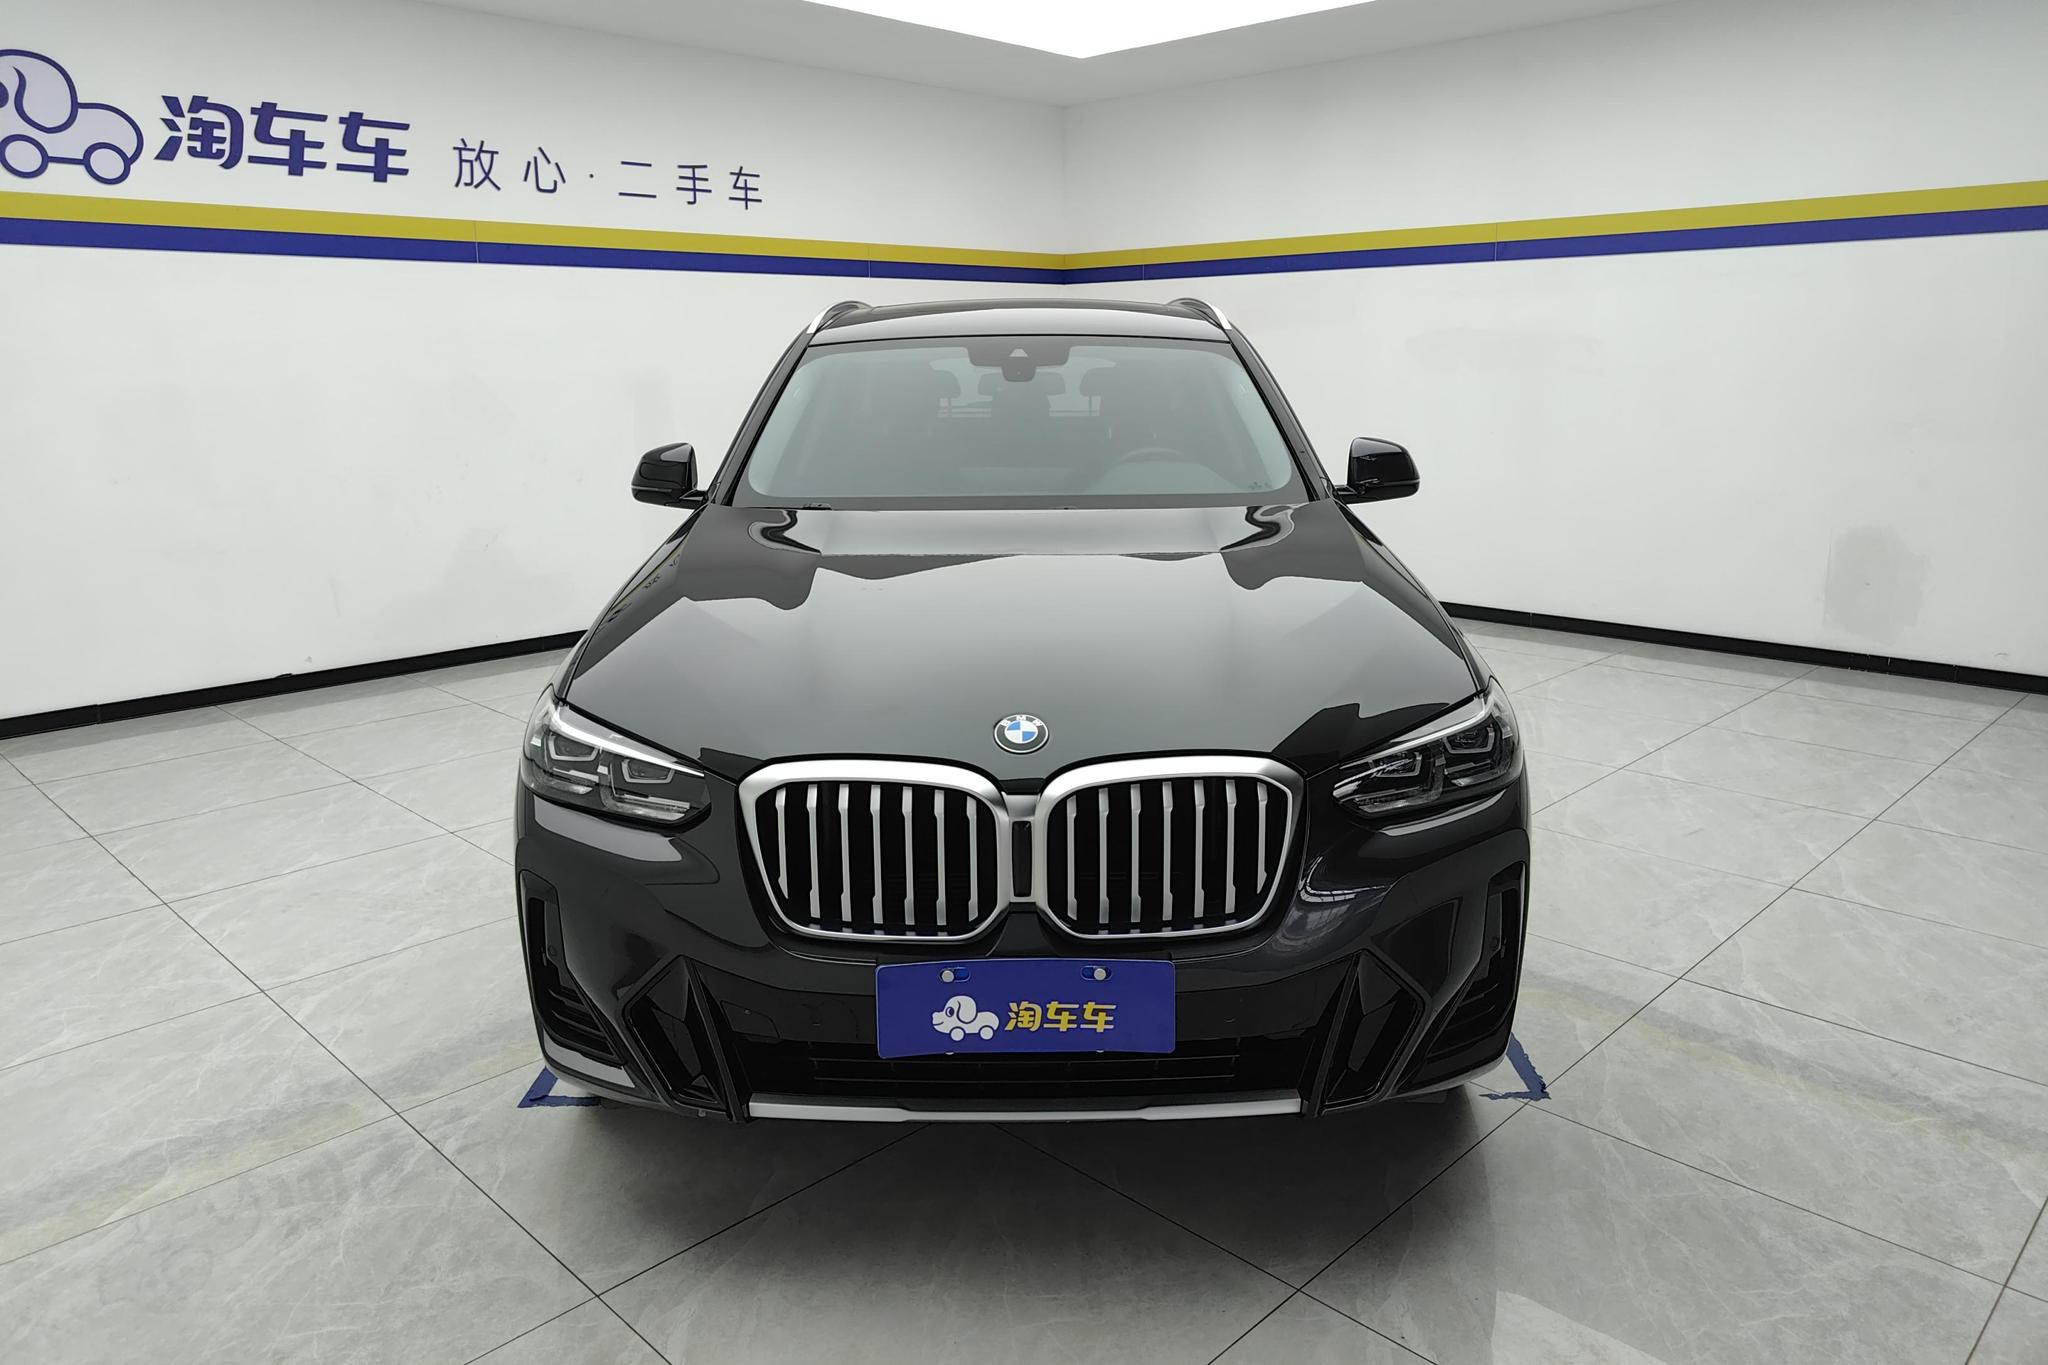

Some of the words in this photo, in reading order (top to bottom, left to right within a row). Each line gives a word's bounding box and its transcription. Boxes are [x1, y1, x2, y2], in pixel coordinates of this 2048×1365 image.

[153, 95, 410, 183] 淘车车
[1004, 1001, 1117, 1033] 淘车车
